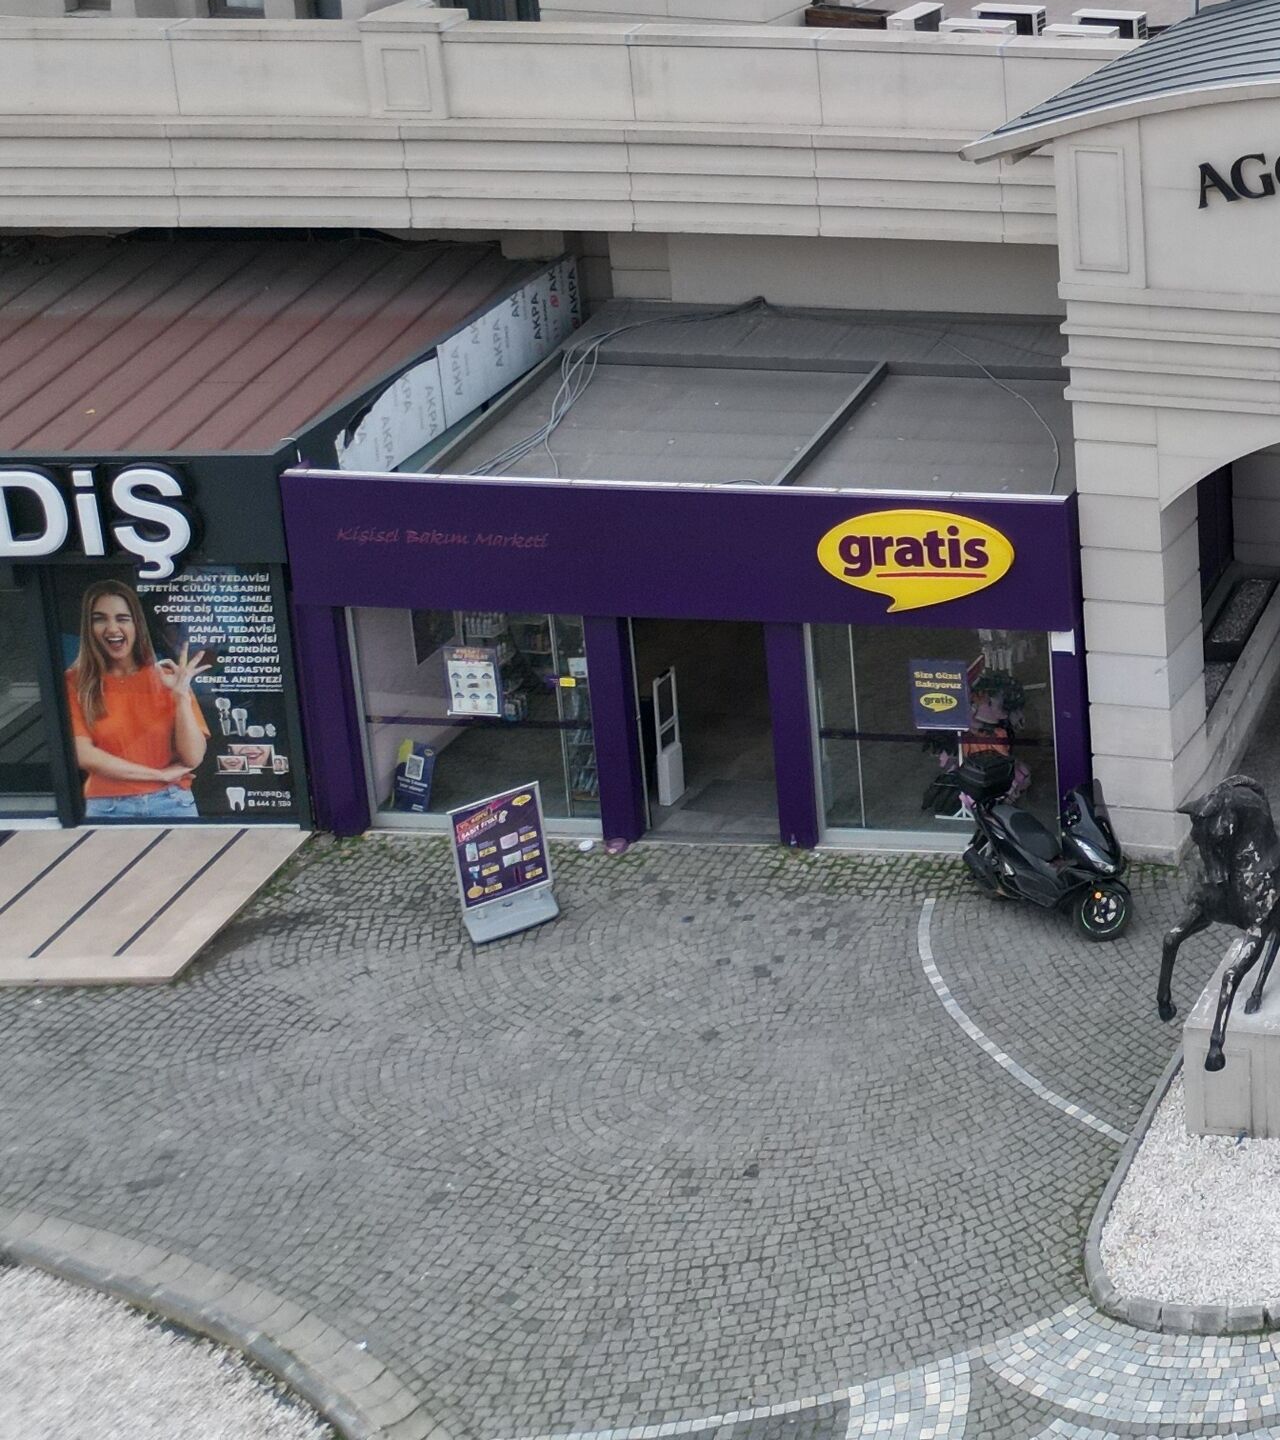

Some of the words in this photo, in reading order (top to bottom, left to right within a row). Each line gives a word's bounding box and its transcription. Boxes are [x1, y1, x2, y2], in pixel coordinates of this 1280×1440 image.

[531, 292, 543, 340] AKPA
[336, 526, 400, 546] Kişisel
[474, 532, 549, 548] Marketi
[838, 525, 990, 578] gratis
[222, 573, 269, 582] TEDAVİSİ
[136, 583, 179, 592] ESTETİK
[168, 595, 237, 603] HOLLYWOOD
[154, 605, 191, 614] ÇOCUK
[166, 614, 214, 623] CERRAHİ
[217, 614, 274, 623] TEDAVİLER
[188, 625, 225, 633] KANAL
[227, 624, 275, 633] TEDAVİSİ
[229, 634, 277, 643] TEDAVİSİ
[216, 654, 279, 663] ORTODONTİ
[195, 676, 229, 684] GENEL
[231, 675, 282, 683] ANESTEZİ
[923, 696, 954, 706] gratis
